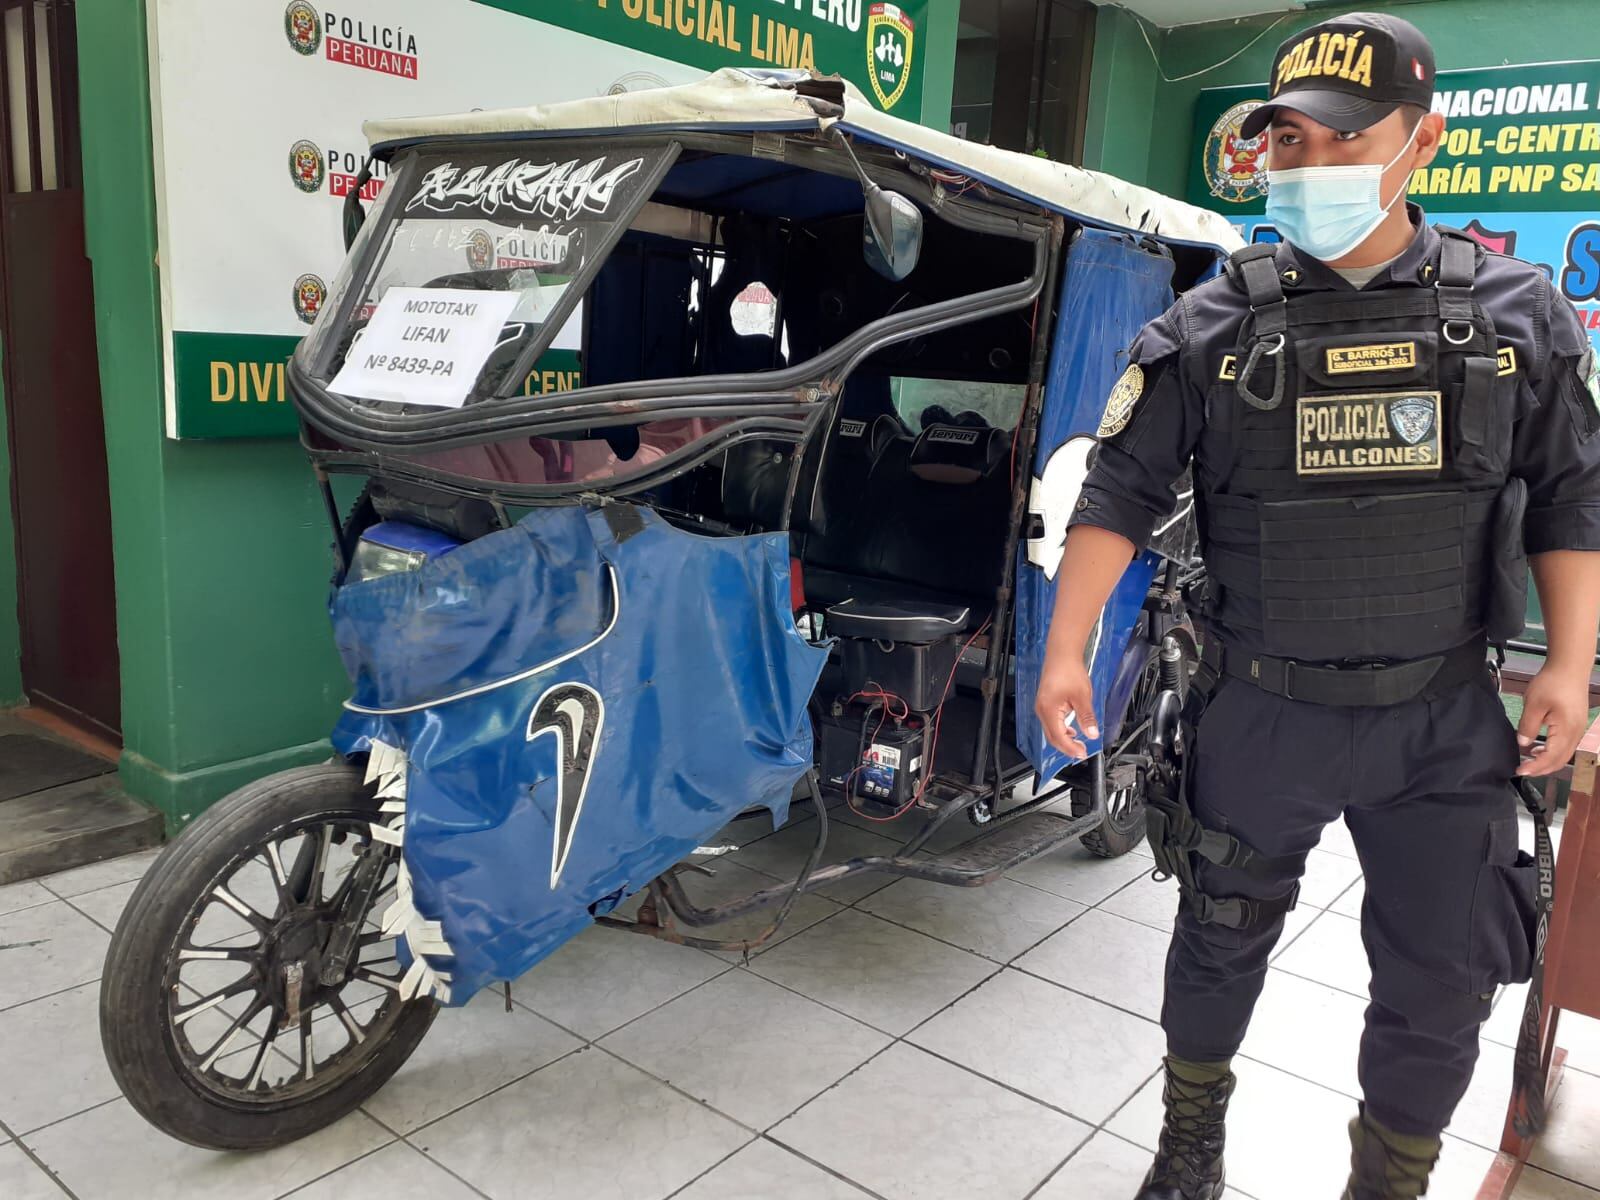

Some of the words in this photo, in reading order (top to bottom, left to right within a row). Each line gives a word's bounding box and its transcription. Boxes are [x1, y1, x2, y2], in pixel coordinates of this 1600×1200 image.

[325, 12, 417, 55] POLICÍA
[751, 14, 814, 70] LIMA
[330, 40, 414, 76] PERUANA
[1273, 30, 1373, 96] POLICÍA
[1430, 82, 1589, 118] NACIONAL
[1488, 164, 1555, 194] PNP
[1560, 163, 1600, 192] SA
[403, 300, 478, 316] MOTOTAXI
[401, 326, 450, 343] LIFAN
[387, 356, 454, 376] 8439-PA
[1332, 352, 1344, 361] G.
[1347, 348, 1395, 360] BARRIOS
[210, 361, 285, 402] DIVI
[1302, 403, 1390, 443] POLICIA
[1304, 445, 1433, 467] HALCONES
[1537, 823, 1553, 898] UMBRO
